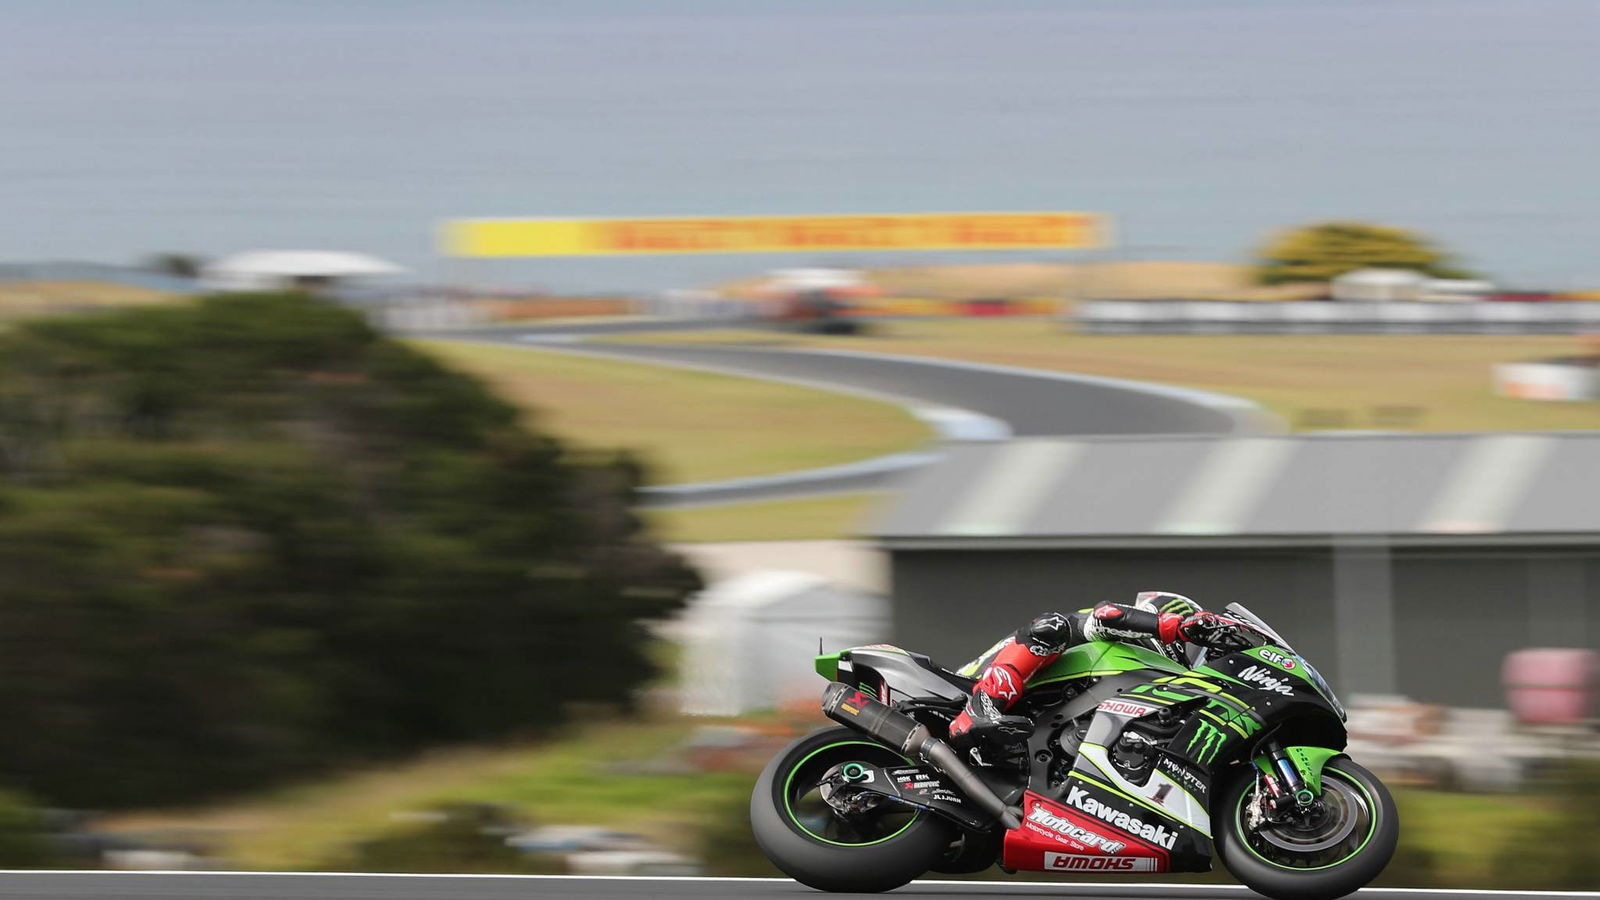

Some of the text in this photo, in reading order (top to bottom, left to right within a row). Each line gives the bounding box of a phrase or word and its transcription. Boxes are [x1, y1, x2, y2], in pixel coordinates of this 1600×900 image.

[1259, 649, 1284, 665] elf
[1237, 665, 1295, 697] Ninja
[1098, 701, 1146, 716] SHOWA
[1163, 758, 1207, 794] MONSTER
[1066, 786, 1179, 851] Kawasaki
